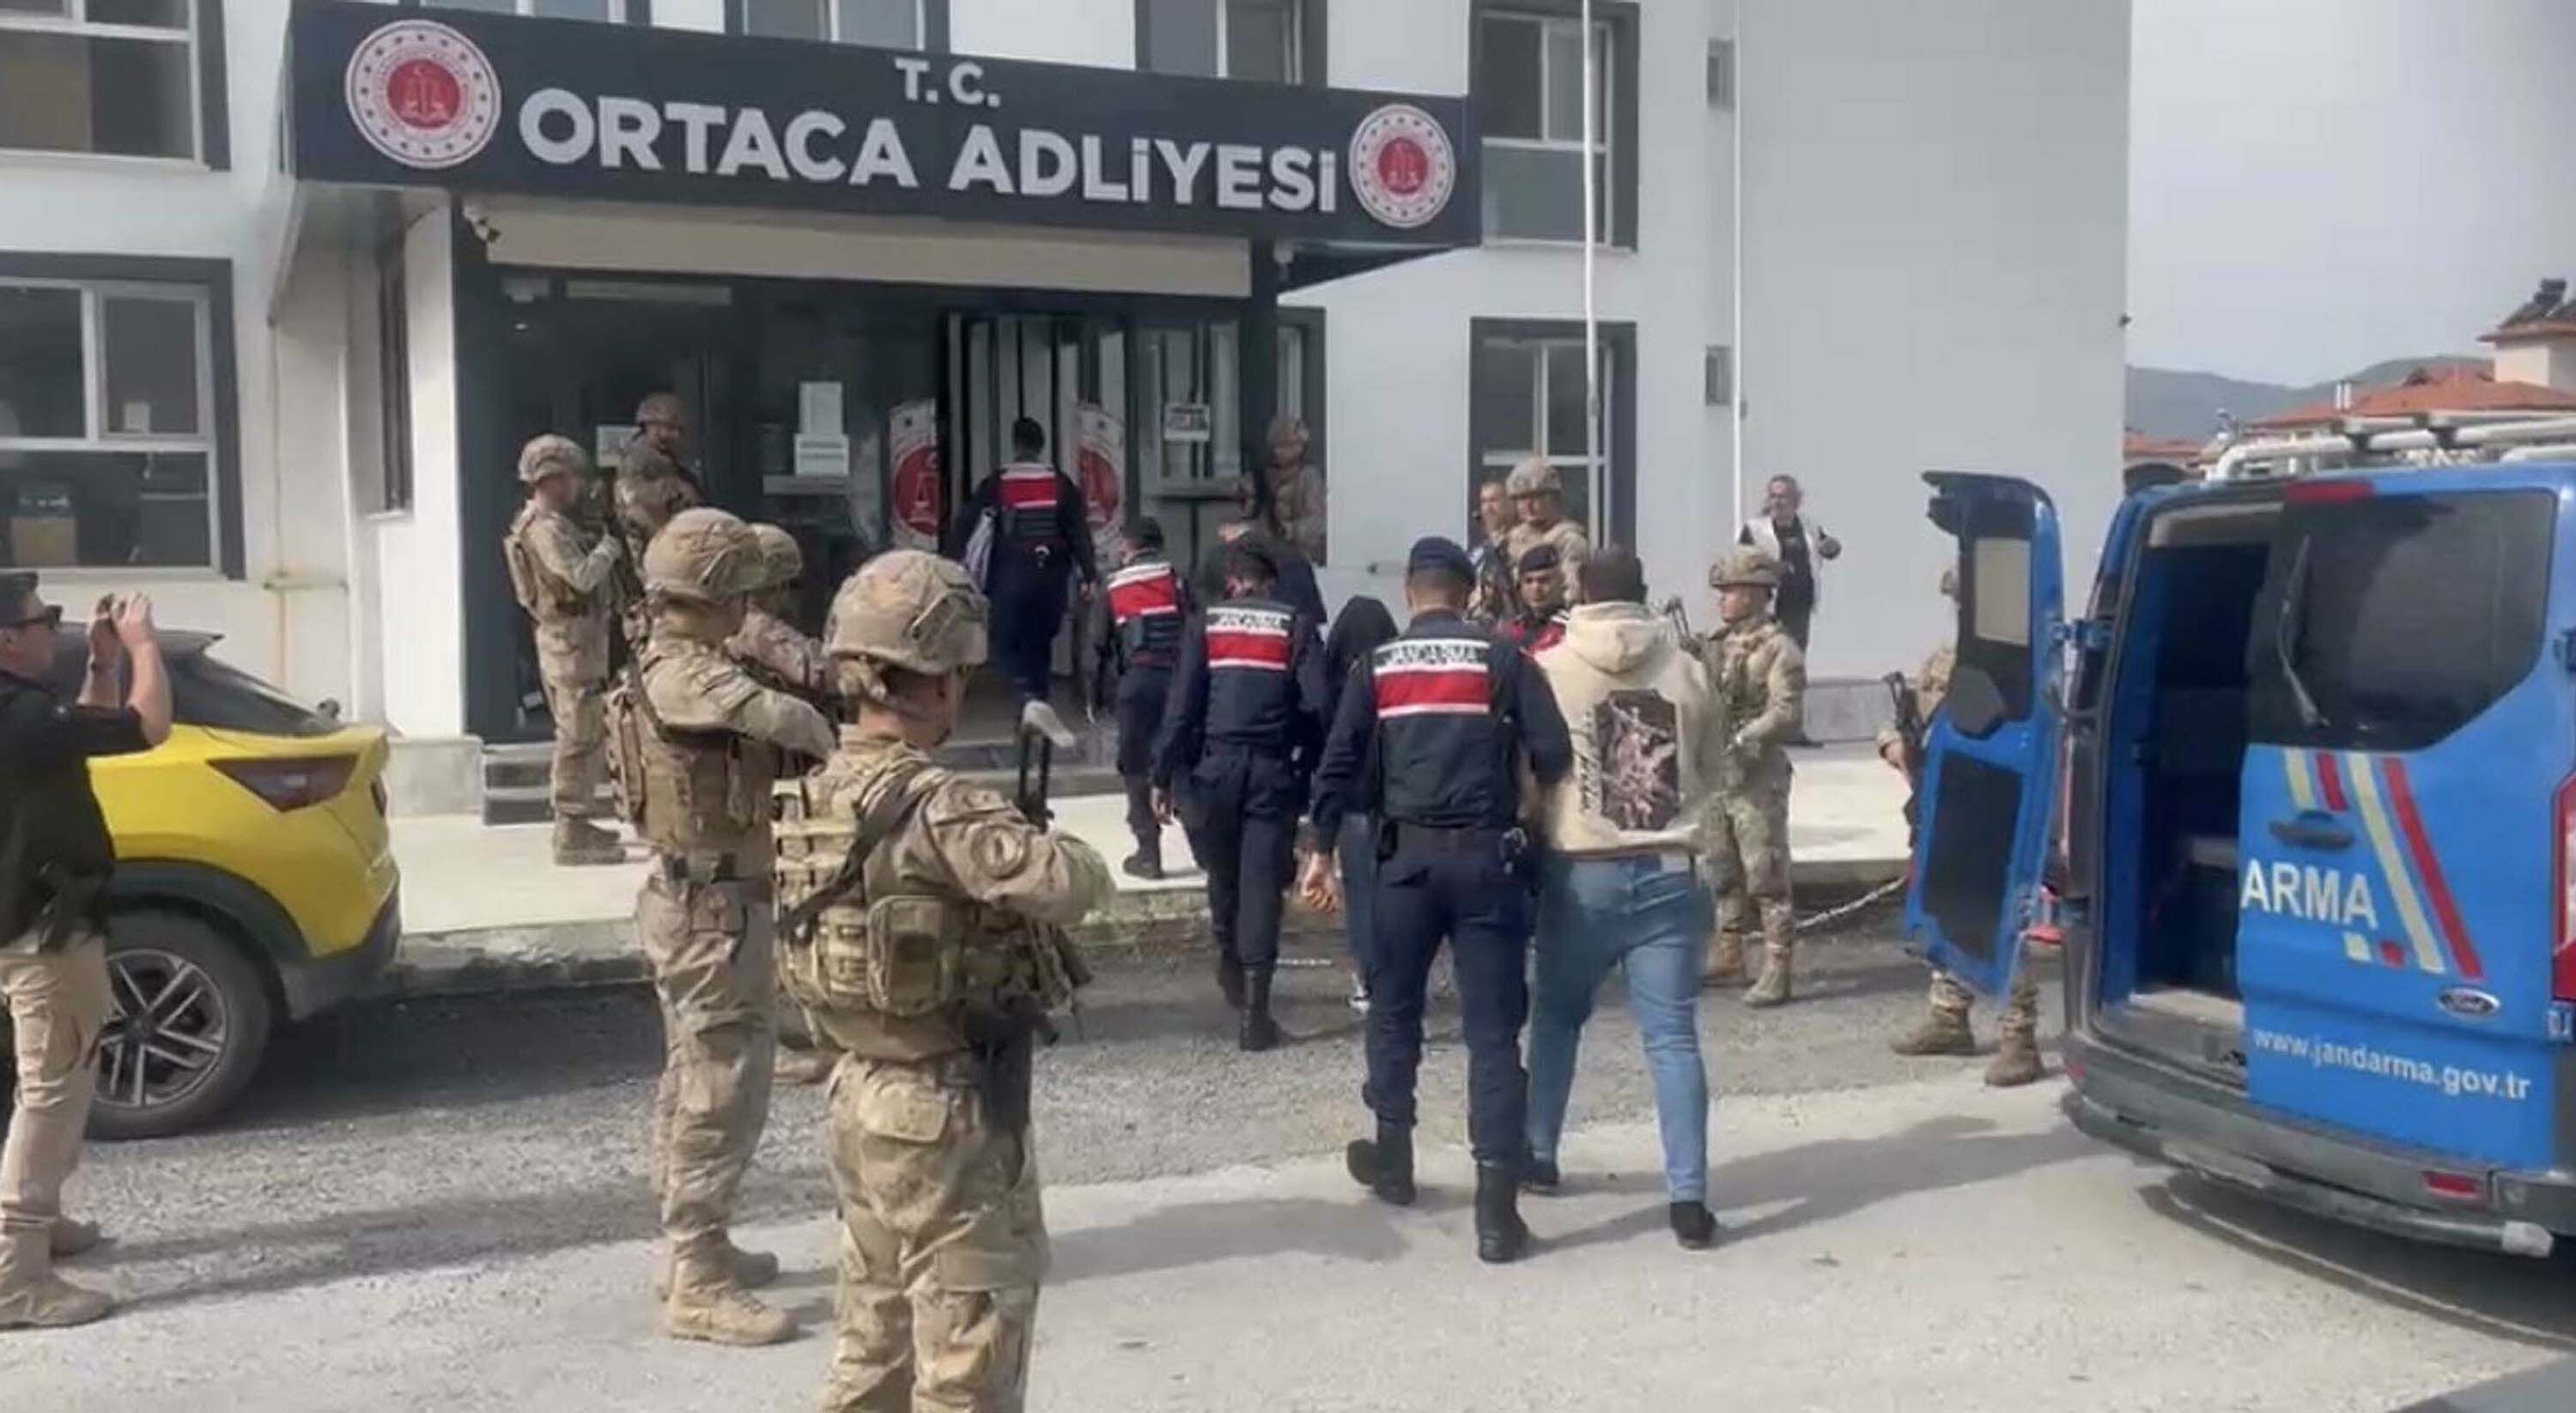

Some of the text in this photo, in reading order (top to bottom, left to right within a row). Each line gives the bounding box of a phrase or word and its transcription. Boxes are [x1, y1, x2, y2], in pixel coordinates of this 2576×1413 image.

[519, 87, 919, 188] ORTACA
[2239, 858, 2379, 931] ARMA
[2251, 1028, 2530, 1100] www.jandarma.gov.tr
